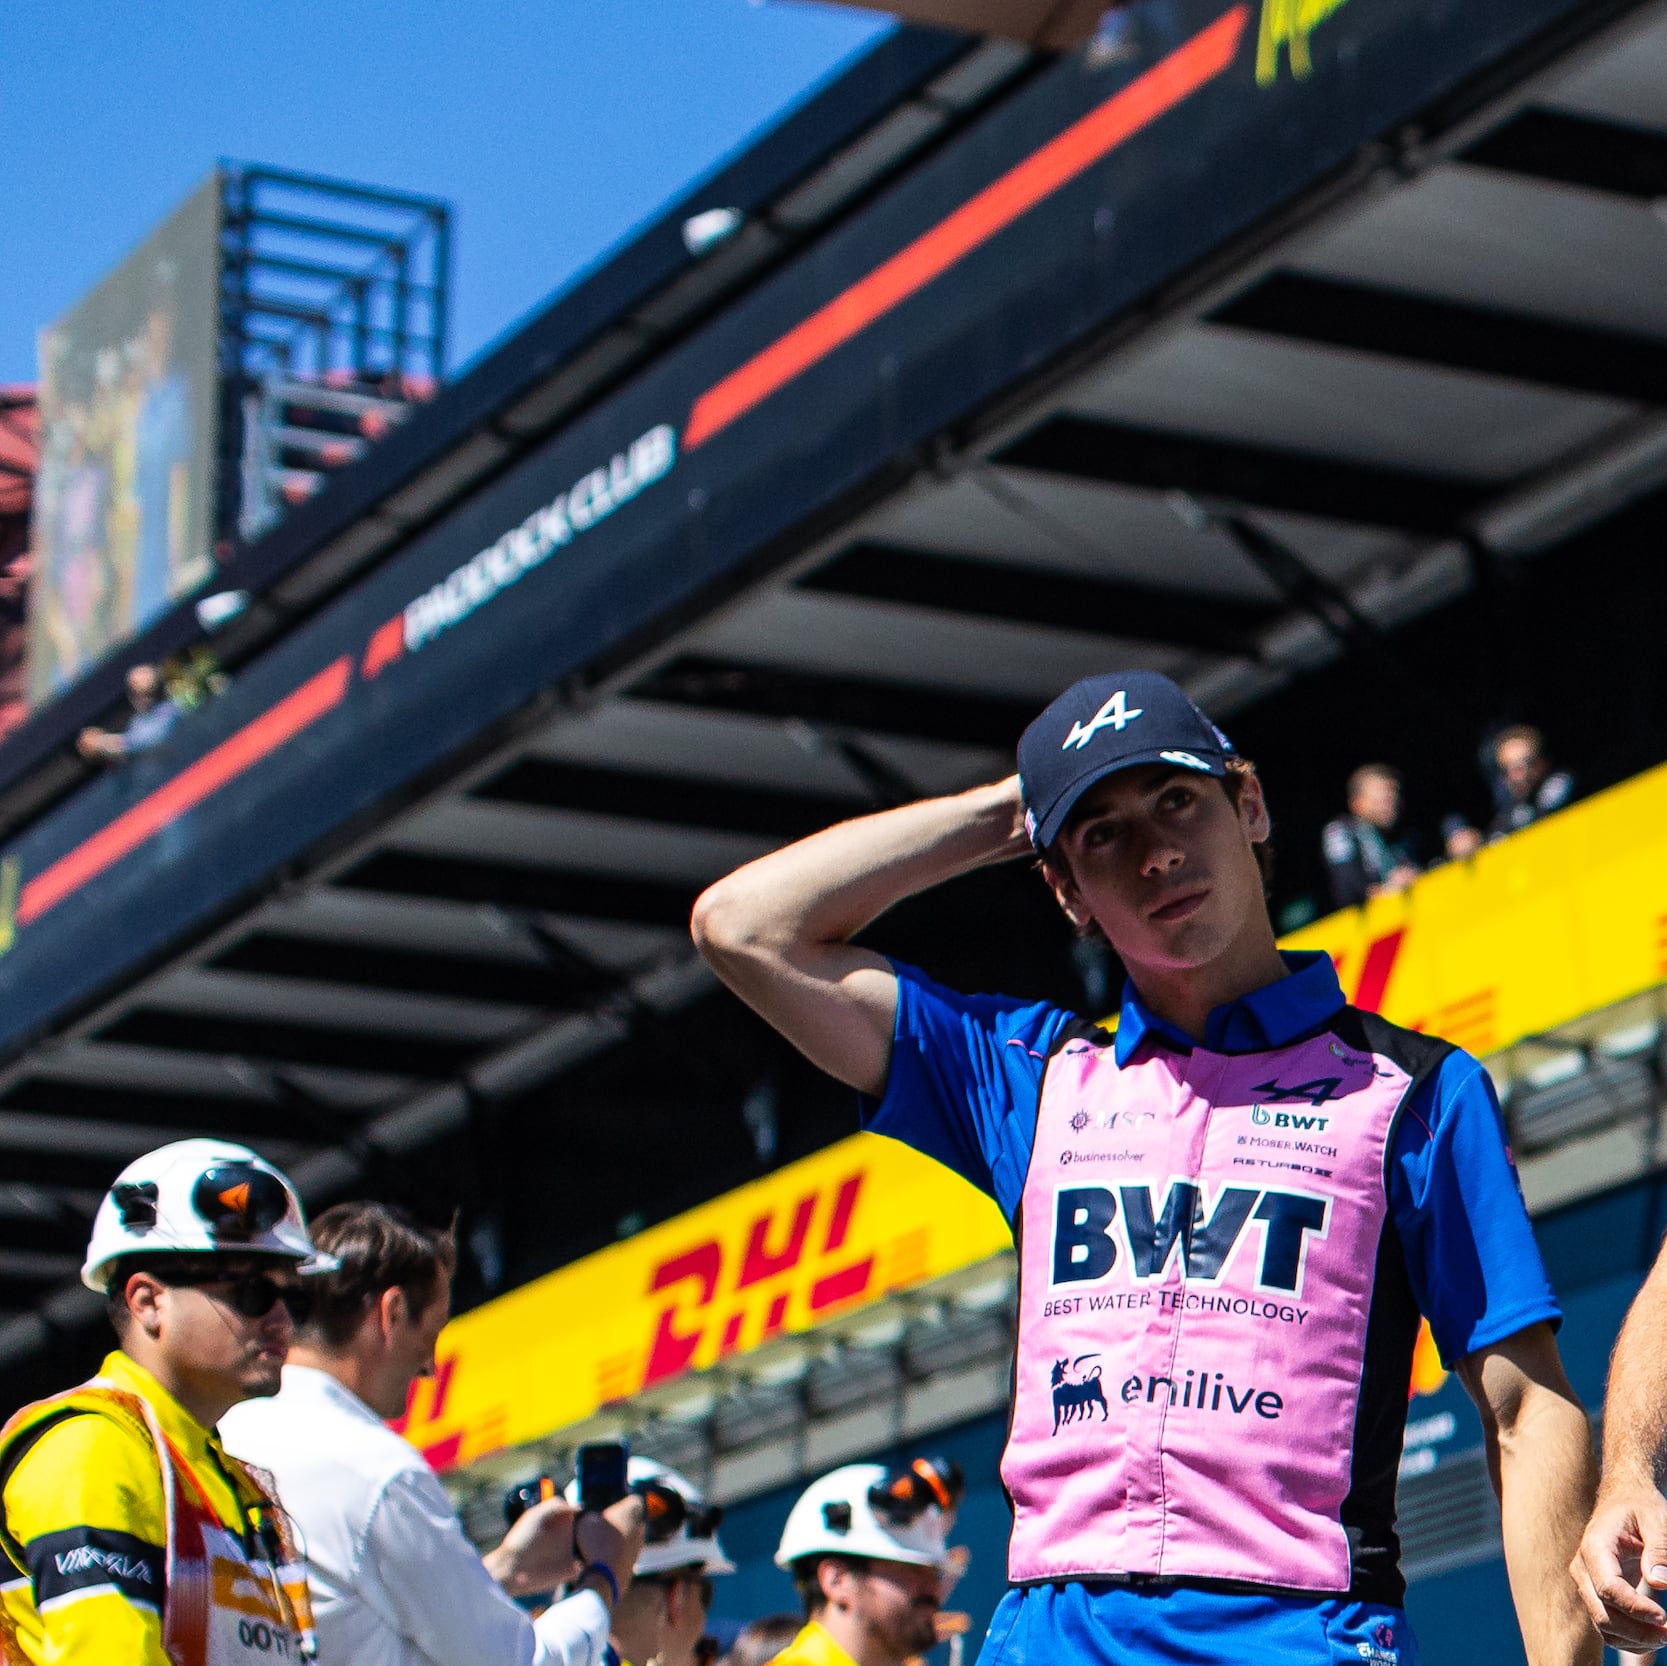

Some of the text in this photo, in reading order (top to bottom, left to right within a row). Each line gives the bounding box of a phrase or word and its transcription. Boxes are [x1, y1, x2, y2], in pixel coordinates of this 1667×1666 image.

[568, 423, 677, 534] CLUB
[1274, 1112, 1330, 1131] BWT
[1073, 1149, 1145, 1163] businessolver
[1049, 1176, 1332, 1298] BWT
[638, 1170, 874, 1392] DHL
[1043, 1290, 1310, 1325] BEST WATER TECHNOLOGY
[1120, 1369, 1285, 1420] enilive
[1358, 1645, 1398, 1664] CHANGE
